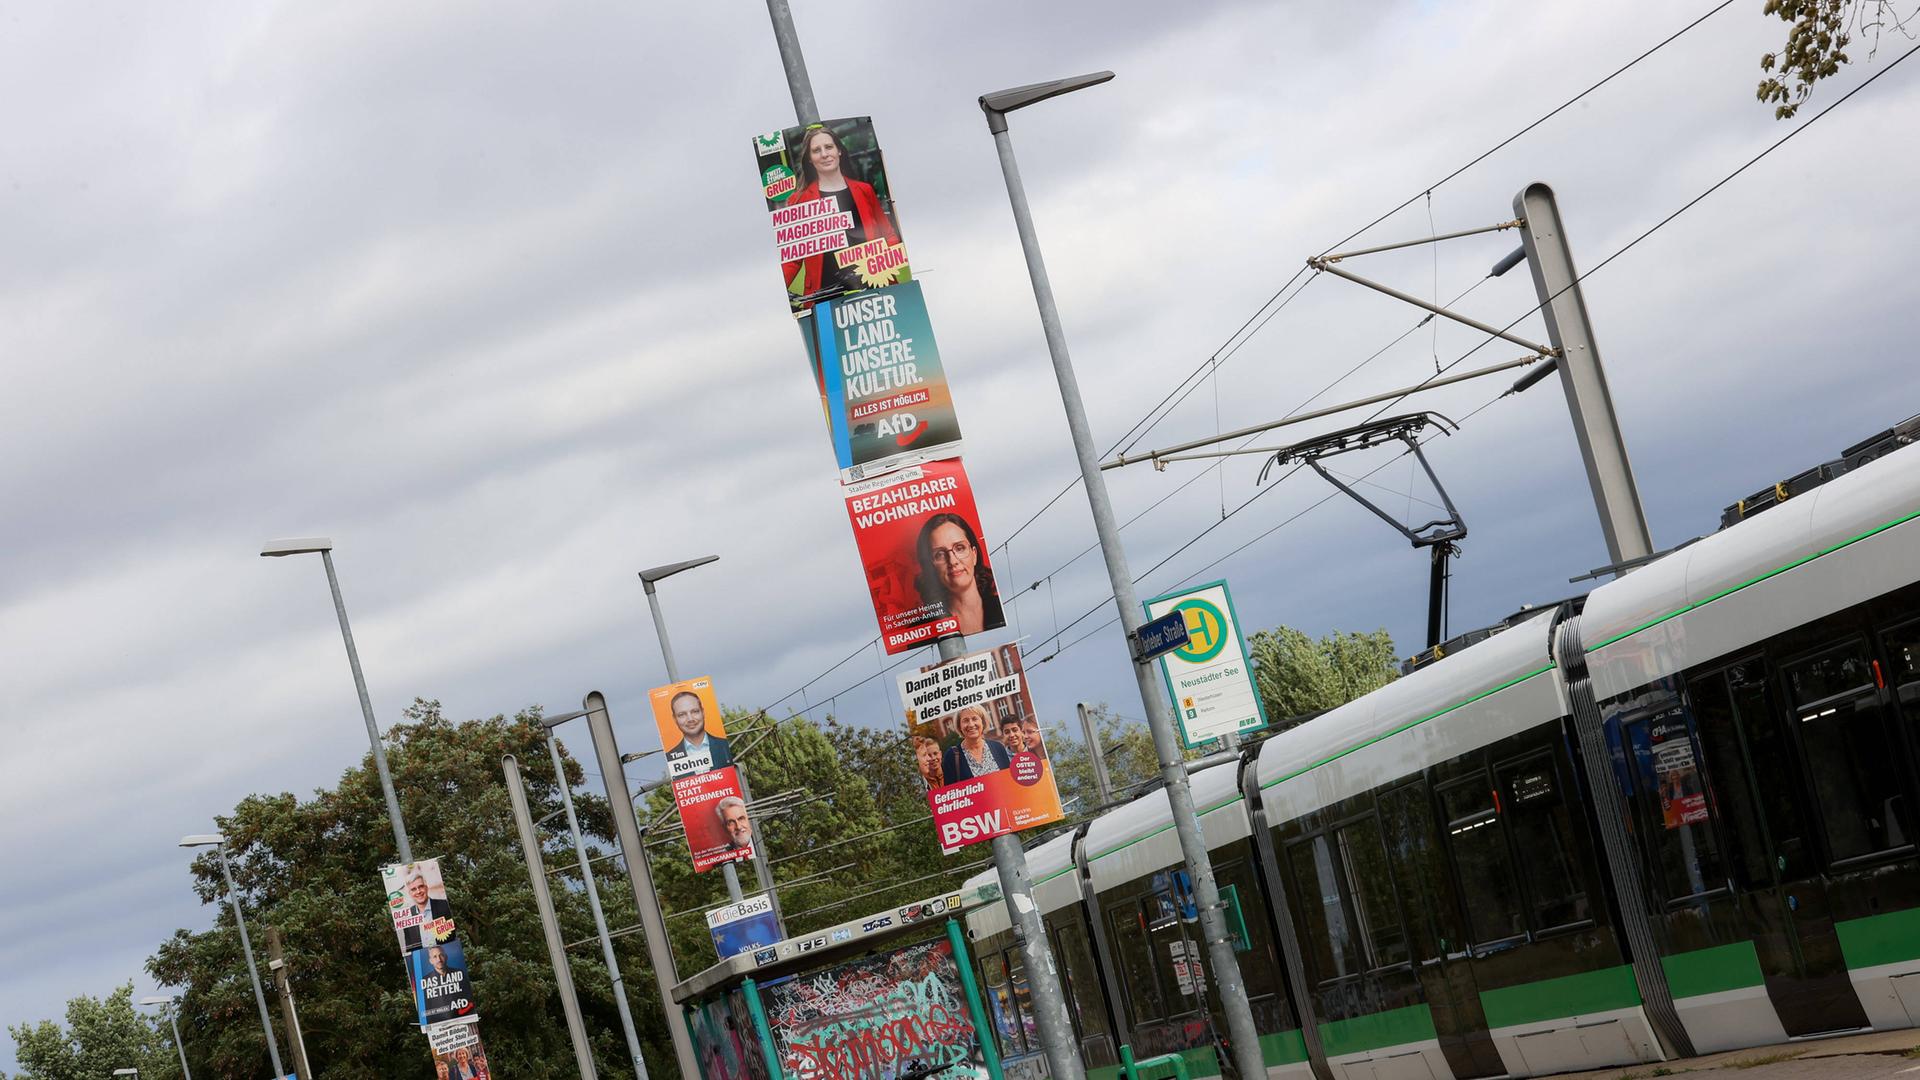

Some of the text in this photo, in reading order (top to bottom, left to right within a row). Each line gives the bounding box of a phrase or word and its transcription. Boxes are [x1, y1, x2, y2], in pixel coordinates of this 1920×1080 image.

[766, 177, 795, 198] GRÜN!
[772, 198, 836, 227] MOBILITÄT,
[777, 215, 852, 244] MAGDEBURG,
[781, 233, 845, 262] MADELEINE
[839, 240, 885, 266] NUR MIT
[867, 246, 908, 275] GRÜN.
[835, 295, 897, 329] UNSER
[844, 319, 900, 352] LAND.
[842, 338, 915, 376] UNSERE
[846, 362, 923, 400] KULTUR.
[854, 391, 928, 418] ALLES IST MÖGLICH.
[877, 413, 917, 438] AfD
[848, 479, 871, 494] Stabile
[872, 472, 904, 489] Regierung
[852, 476, 958, 514] BEZAHLBARER
[856, 494, 956, 529] WOHNRAUM
[883, 601, 943, 623] Für unsere Heimat
[886, 622, 892, 630] in
[889, 619, 958, 646] BRANDT SPD
[1163, 620, 1185, 643] Straße
[905, 658, 988, 694] Damit Bildung
[1181, 667, 1239, 688] Neustädter See
[913, 674, 985, 707] wieder Stolz
[920, 679, 1017, 720] des Ostens wird!
[670, 751, 685, 760] Tim
[674, 756, 710, 773] Rohne
[675, 772, 724, 791] ERFAHRUNG
[678, 786, 702, 799] STATT
[680, 787, 735, 807] EXPERIMENTE
[934, 782, 984, 804] Gefährlich
[937, 798, 974, 815] ehrlich.
[941, 809, 1001, 845] BSW
[697, 852, 737, 867] WILLINGMANN
[393, 908, 410, 919] OLAF
[722, 900, 768, 920] dieBasis
[396, 915, 423, 929] MEISTER
[423, 917, 444, 930] NUR MIT
[420, 971, 463, 990] DAS LAND
[426, 982, 462, 999] RETTEN.
[451, 998, 469, 1011] AfD
[432, 1031, 448, 1041] Damit
[436, 1036, 454, 1047] wieder
[439, 1046, 449, 1054] des
[449, 1040, 466, 1050] Ostens
